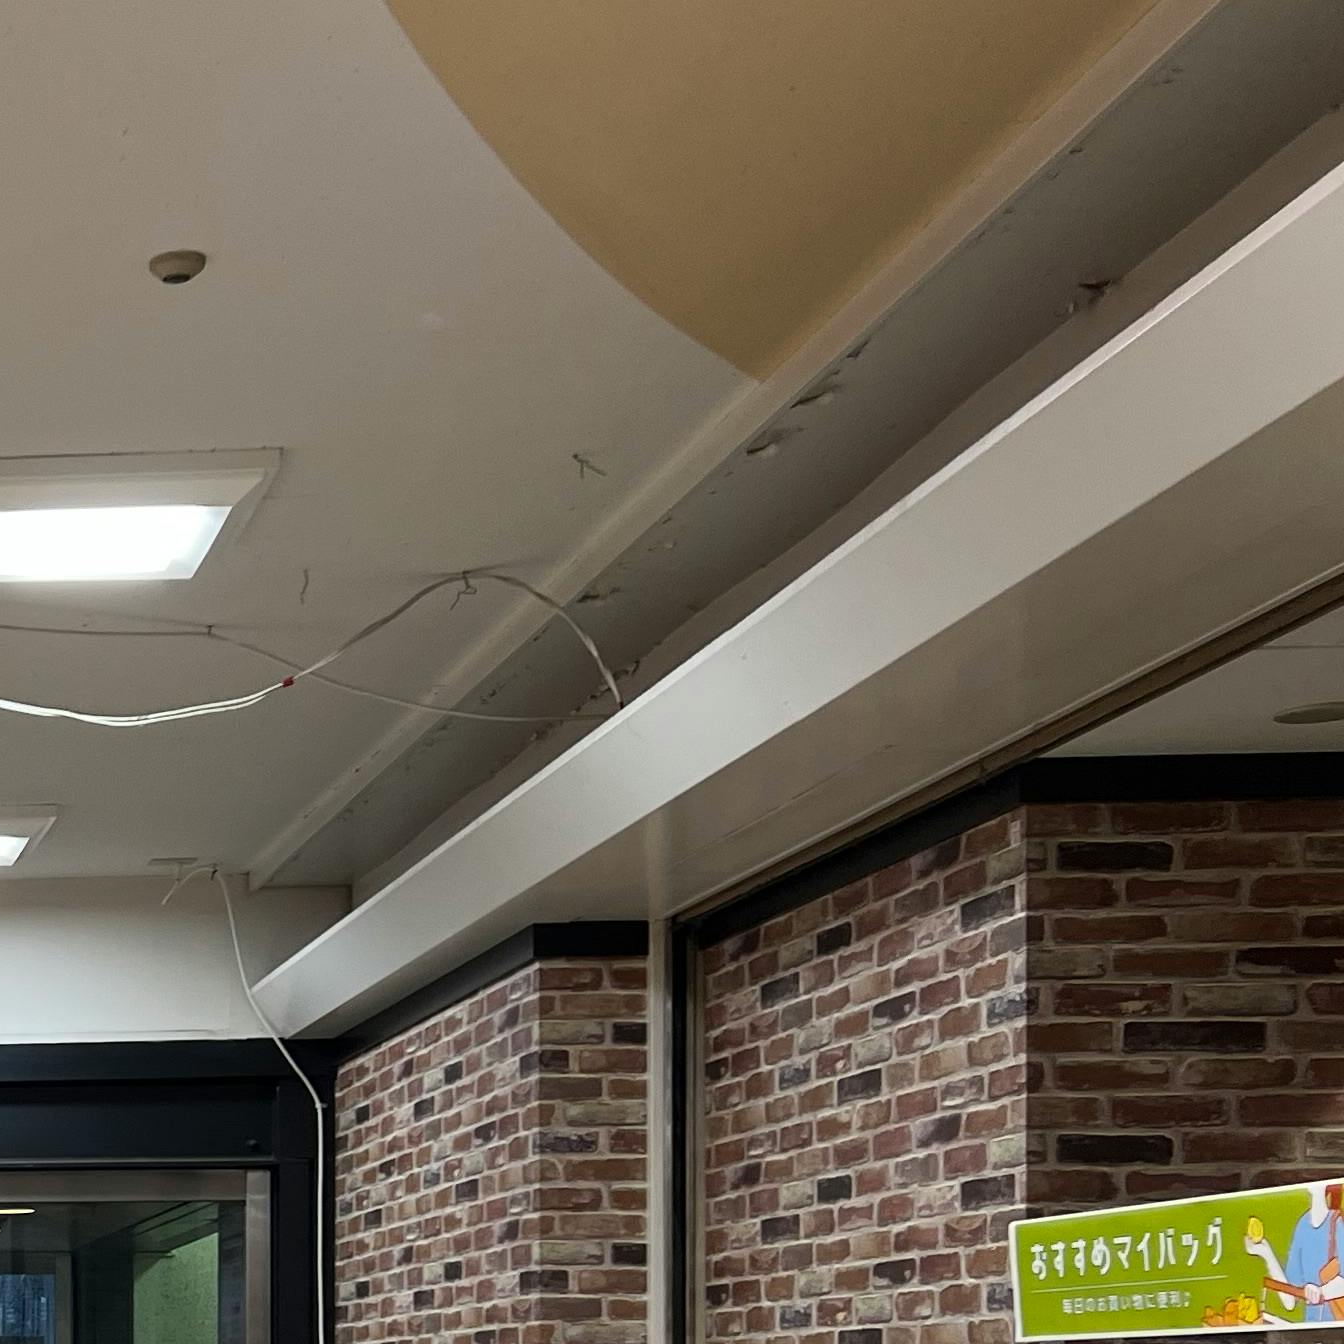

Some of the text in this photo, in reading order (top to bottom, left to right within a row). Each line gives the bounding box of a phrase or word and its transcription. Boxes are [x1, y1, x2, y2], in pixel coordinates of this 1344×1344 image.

[1030, 1216, 1223, 1281] おすすめマイバッグ
